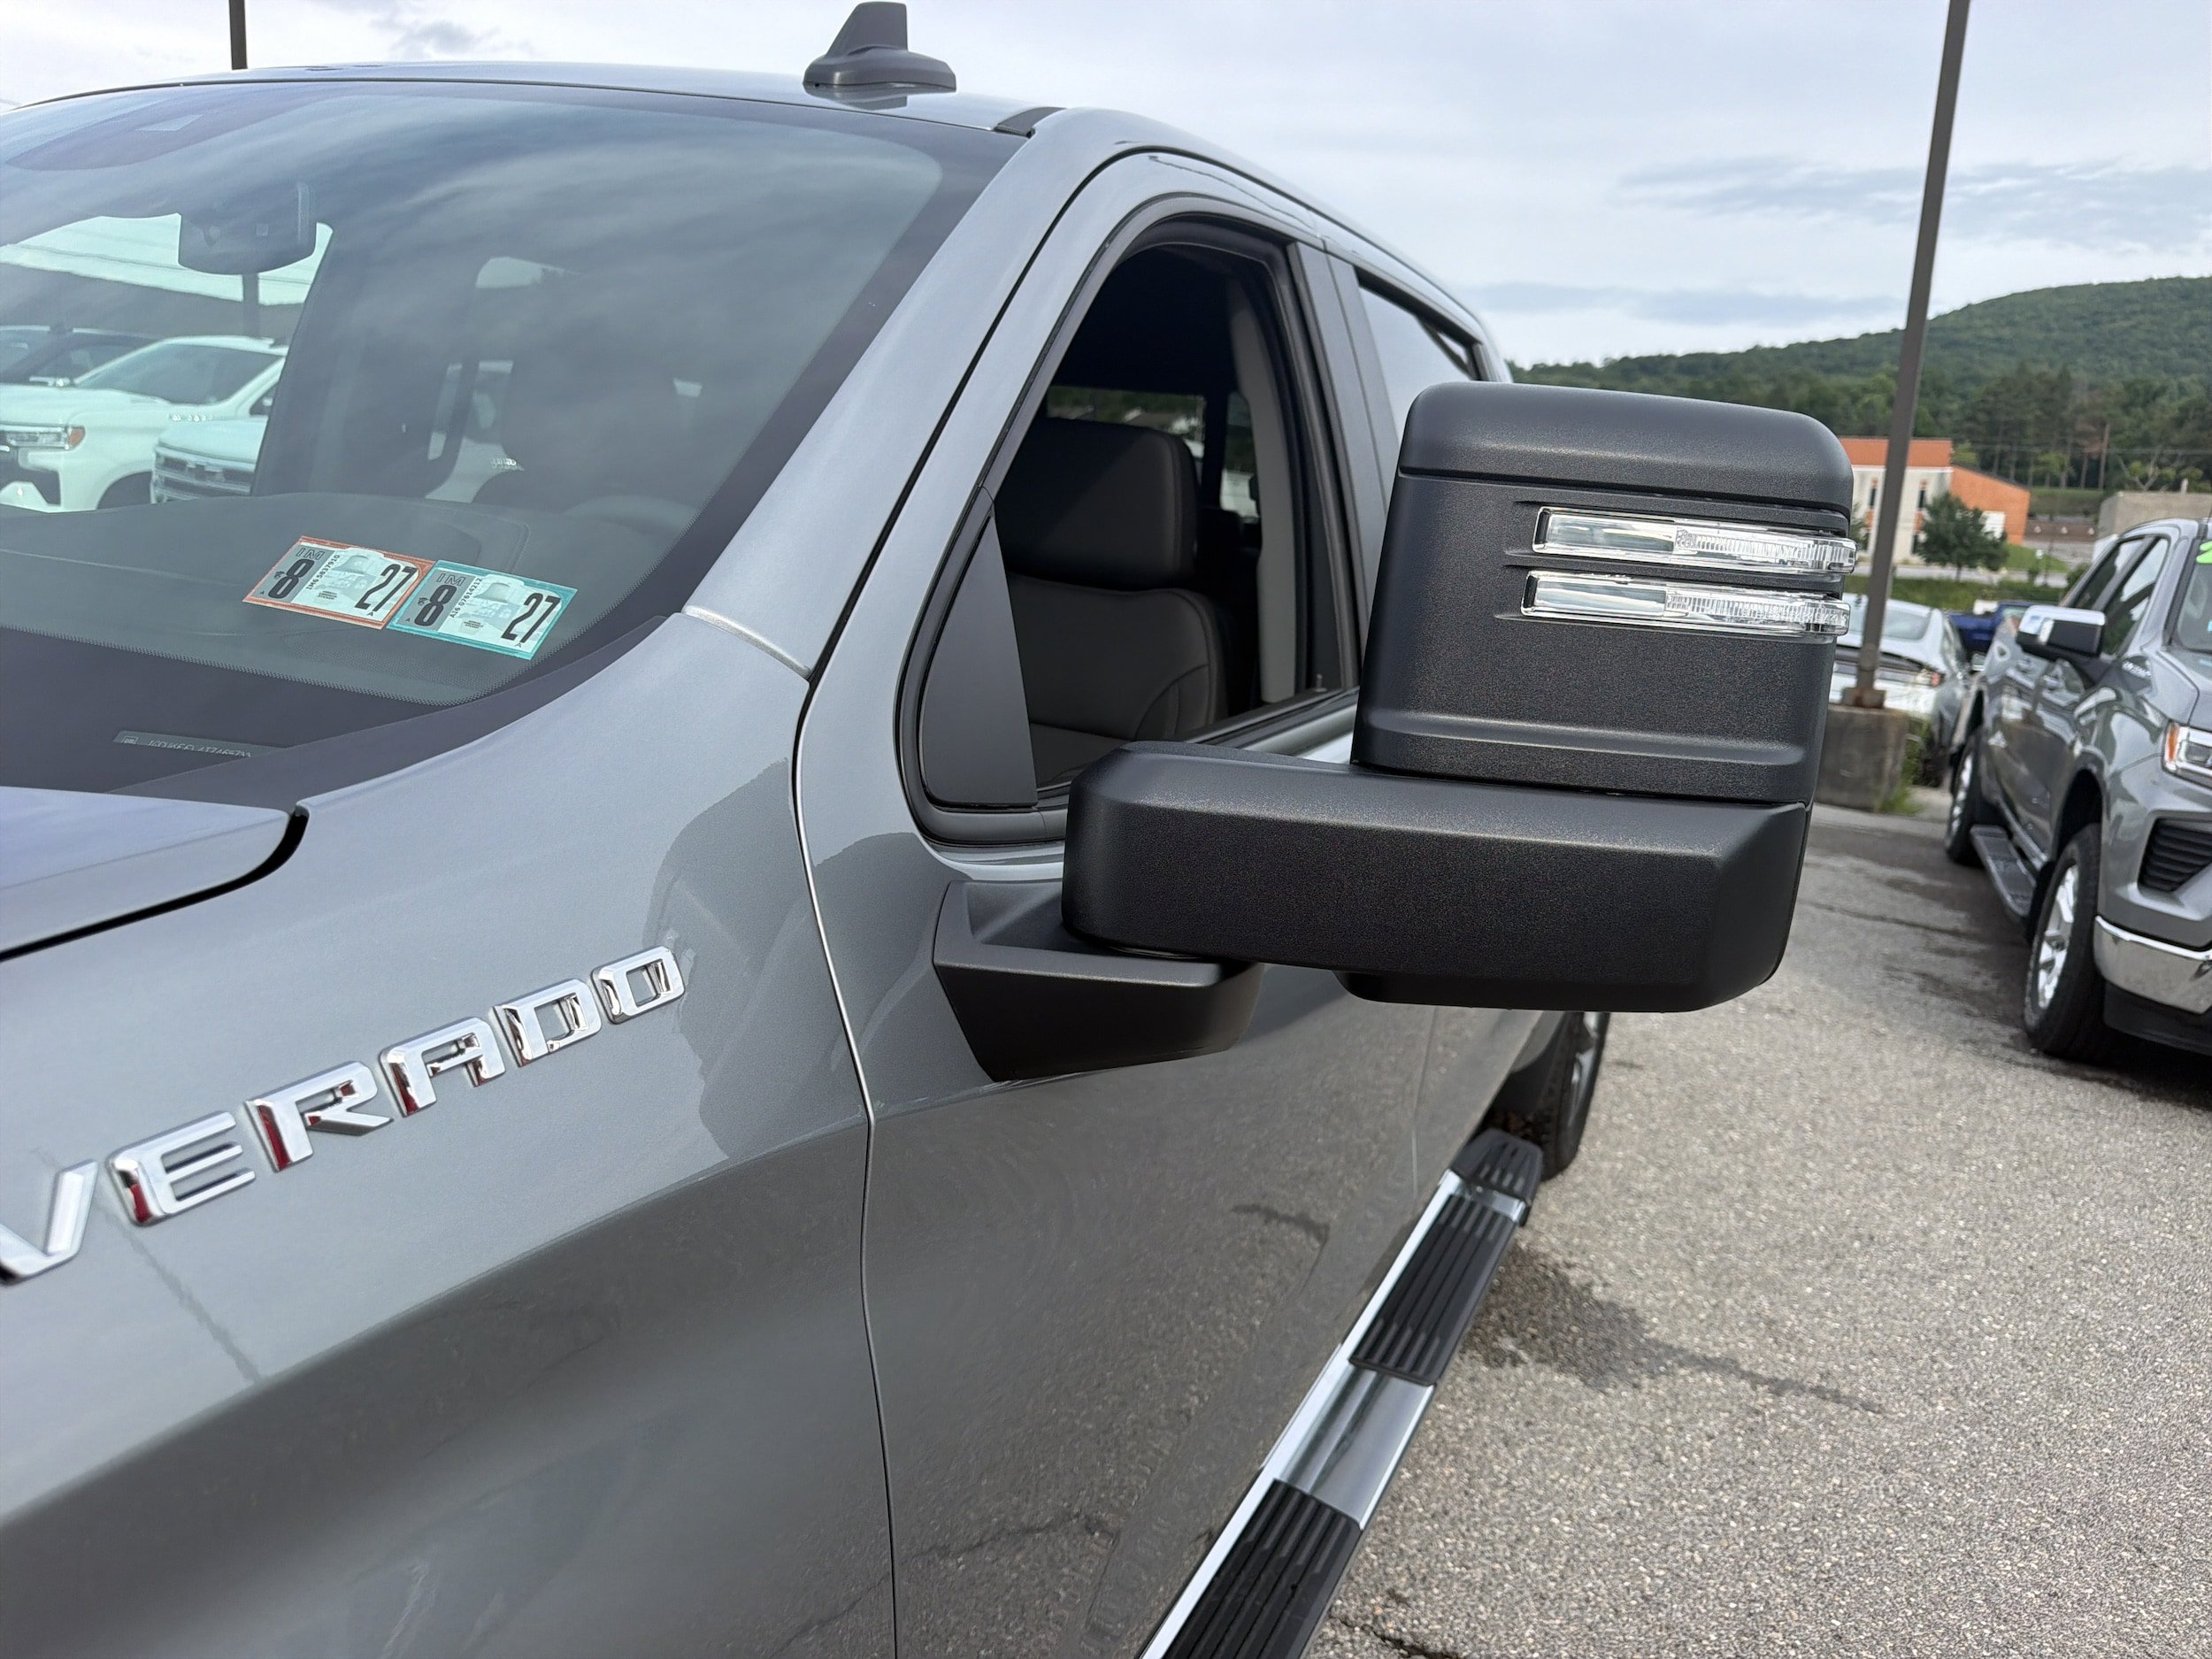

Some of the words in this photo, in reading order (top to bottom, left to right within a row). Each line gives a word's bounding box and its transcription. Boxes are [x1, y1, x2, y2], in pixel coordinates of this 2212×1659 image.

[296, 548, 326, 560] IM
[267, 558, 315, 599] 8
[354, 564, 419, 611] 27
[436, 572, 466, 587] IM
[414, 584, 457, 626] 8
[501, 592, 562, 643] 27
[0, 945, 686, 1286] VERADO
